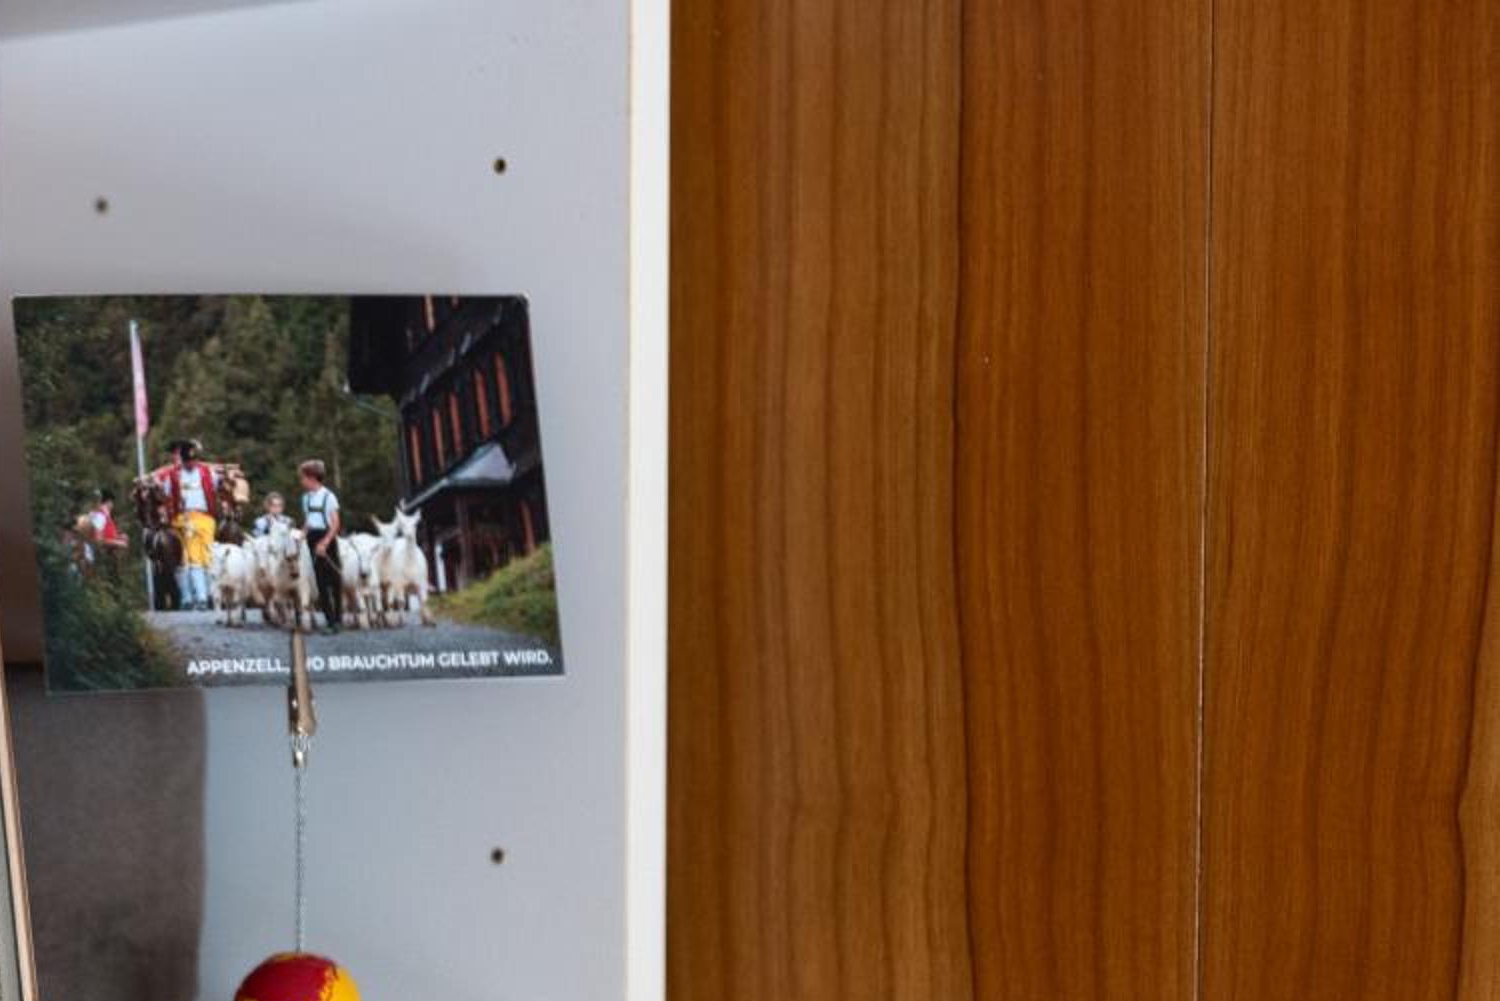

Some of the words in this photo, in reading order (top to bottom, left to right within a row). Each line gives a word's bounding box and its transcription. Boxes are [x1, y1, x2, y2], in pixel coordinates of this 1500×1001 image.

[187, 657, 290, 675] APPENZELL,
[328, 652, 435, 672] BRAUCHTUM
[438, 651, 500, 670] GELEBT
[503, 649, 553, 668] WIRD.
